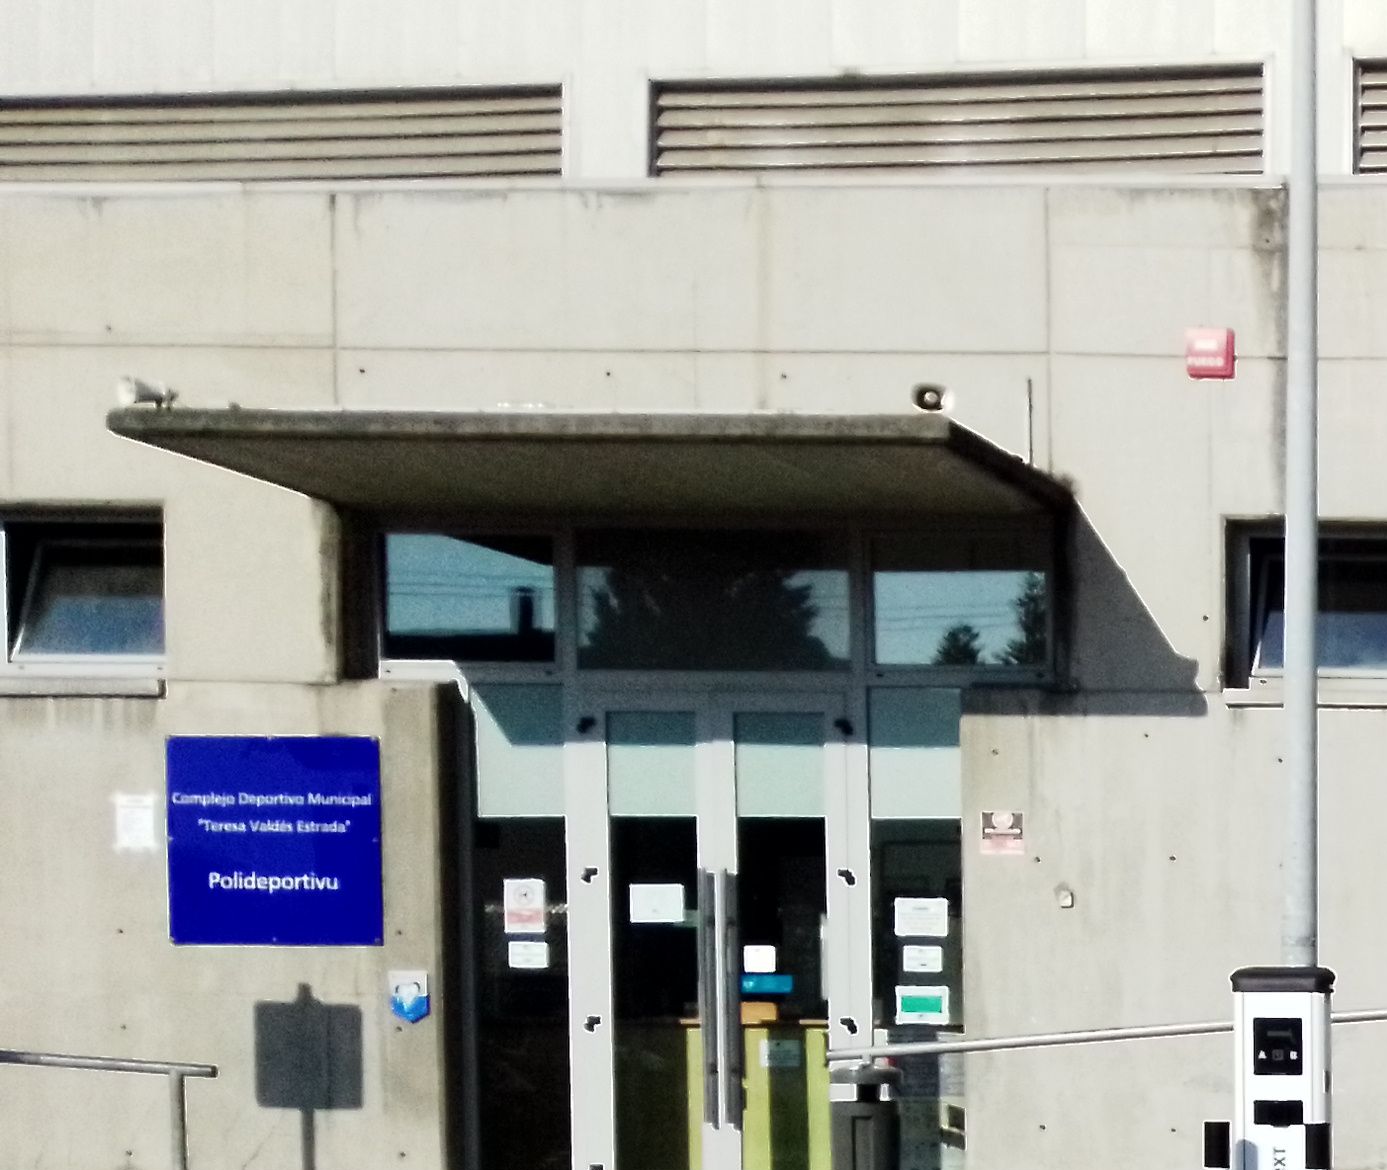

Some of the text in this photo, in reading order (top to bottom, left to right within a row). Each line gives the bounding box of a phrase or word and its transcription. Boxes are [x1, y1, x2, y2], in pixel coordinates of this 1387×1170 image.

[171, 792, 372, 807] Complejo Deportivo Municipal
[208, 871, 340, 894] Polideportivu
[1258, 1050, 1267, 1060] A
